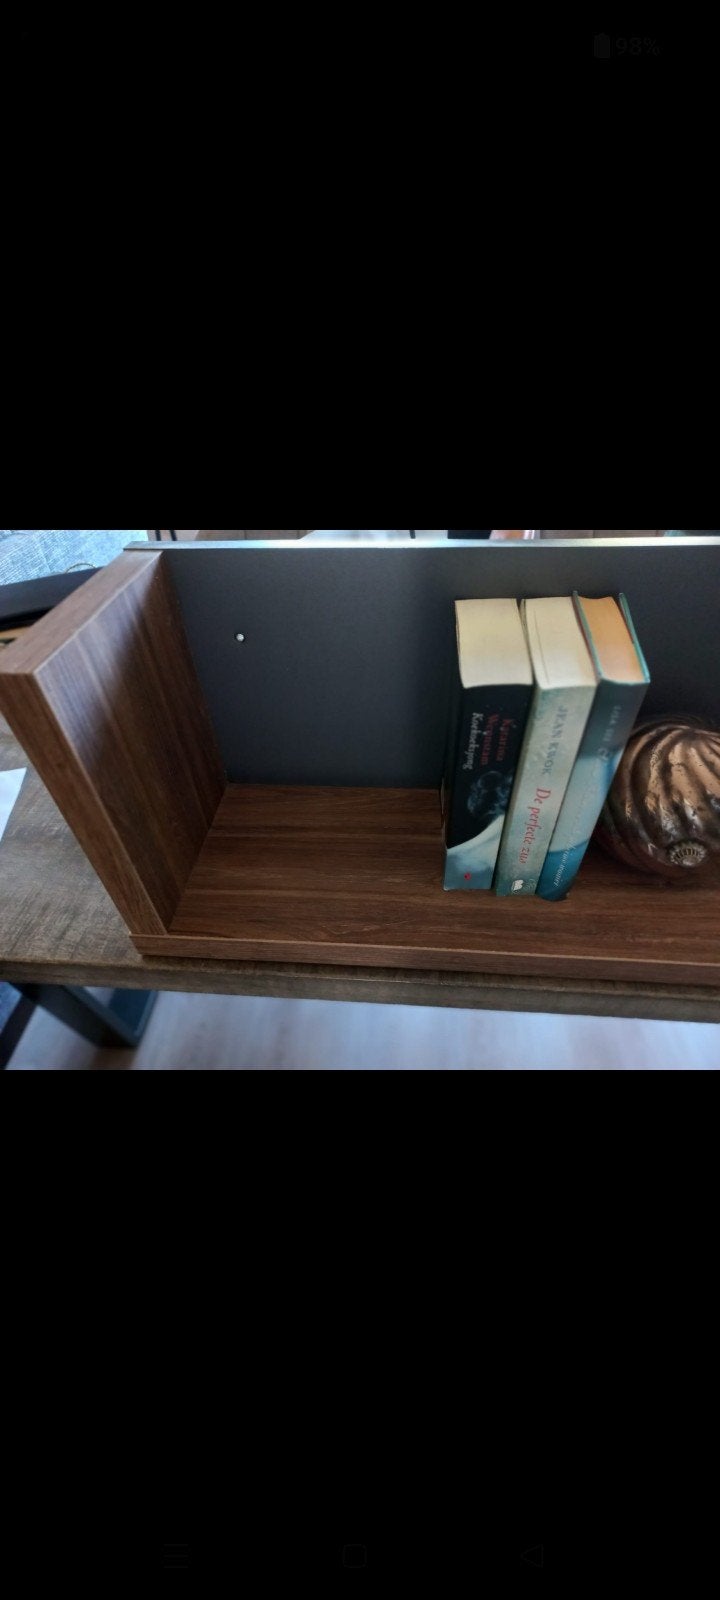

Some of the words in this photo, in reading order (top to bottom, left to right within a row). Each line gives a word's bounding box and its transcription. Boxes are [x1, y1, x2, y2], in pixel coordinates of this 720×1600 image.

[550, 705, 568, 738] JEAN
[462, 712, 484, 770] Koekoeksjong
[541, 742, 559, 775] KWOK
[534, 788, 552, 805] De
[523, 806, 542, 845] perfecte
